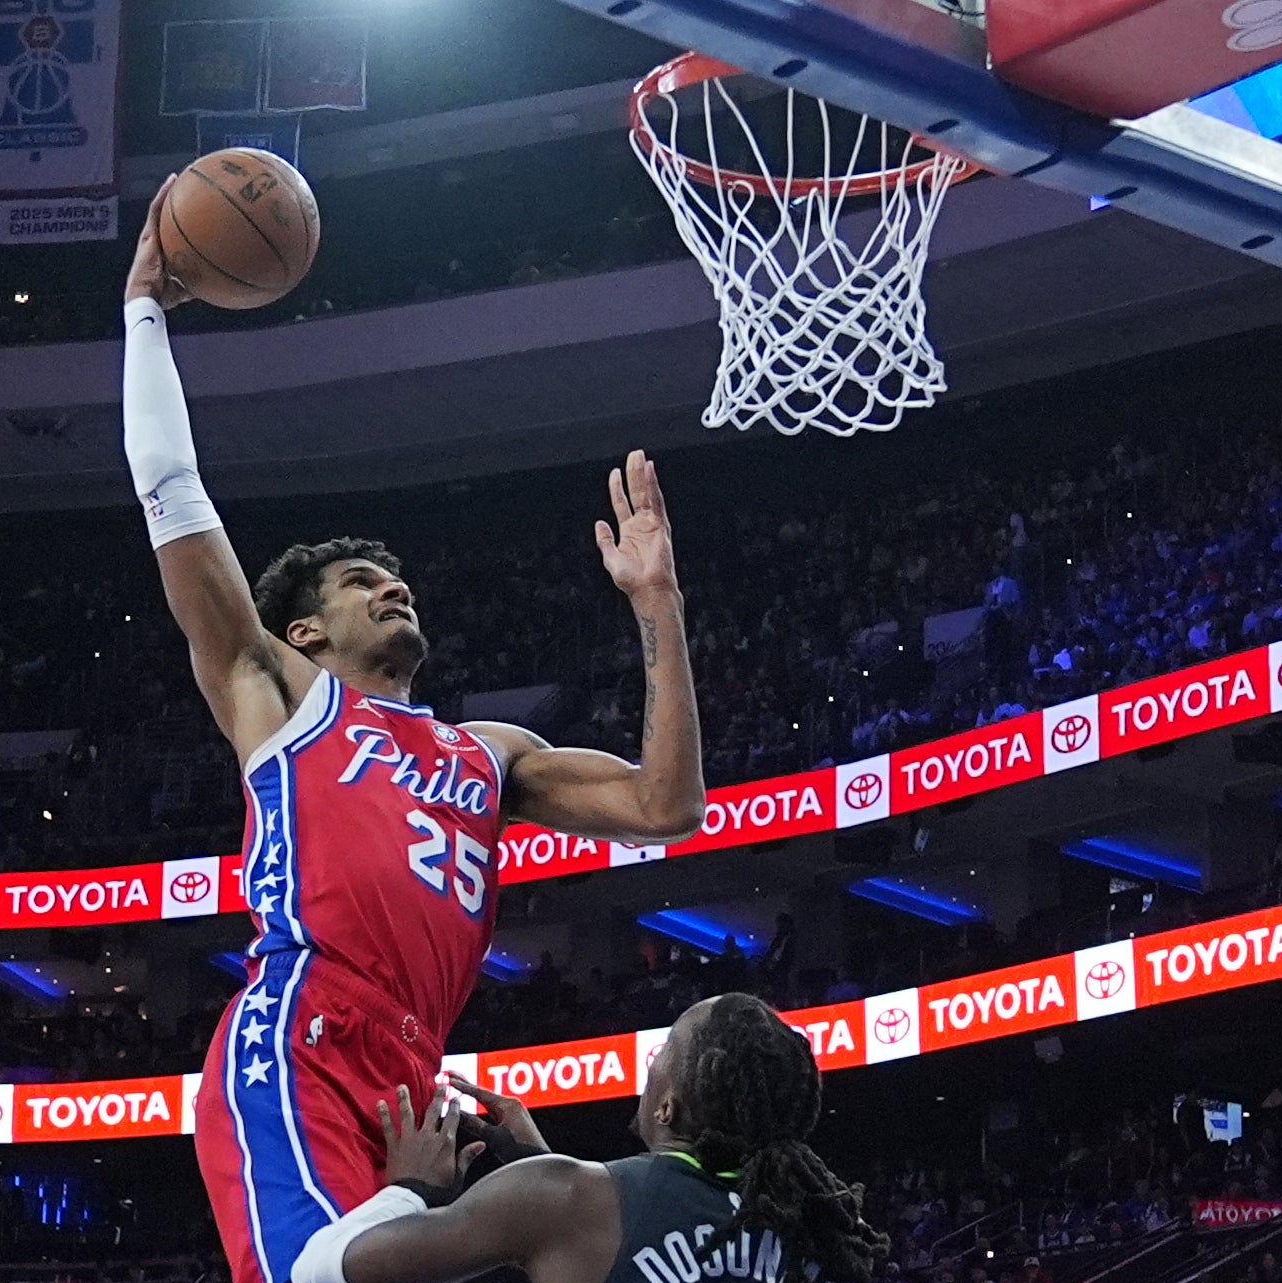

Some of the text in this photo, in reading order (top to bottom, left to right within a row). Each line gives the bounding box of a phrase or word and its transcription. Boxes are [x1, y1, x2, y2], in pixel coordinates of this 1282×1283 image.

[10, 208, 53, 220] 2025
[10, 219, 109, 236] CHAMPIONS
[1112, 670, 1255, 735] TOYOTA
[338, 724, 487, 815] Phila
[902, 733, 1031, 794] TOYOTA
[701, 787, 822, 834] OYOTA
[405, 809, 491, 914] 25
[6, 879, 148, 913] TOYOTA
[929, 975, 1065, 1032] TOYOTA
[487, 1051, 625, 1094] TOYOTA
[26, 1091, 170, 1128] TOYOTA
